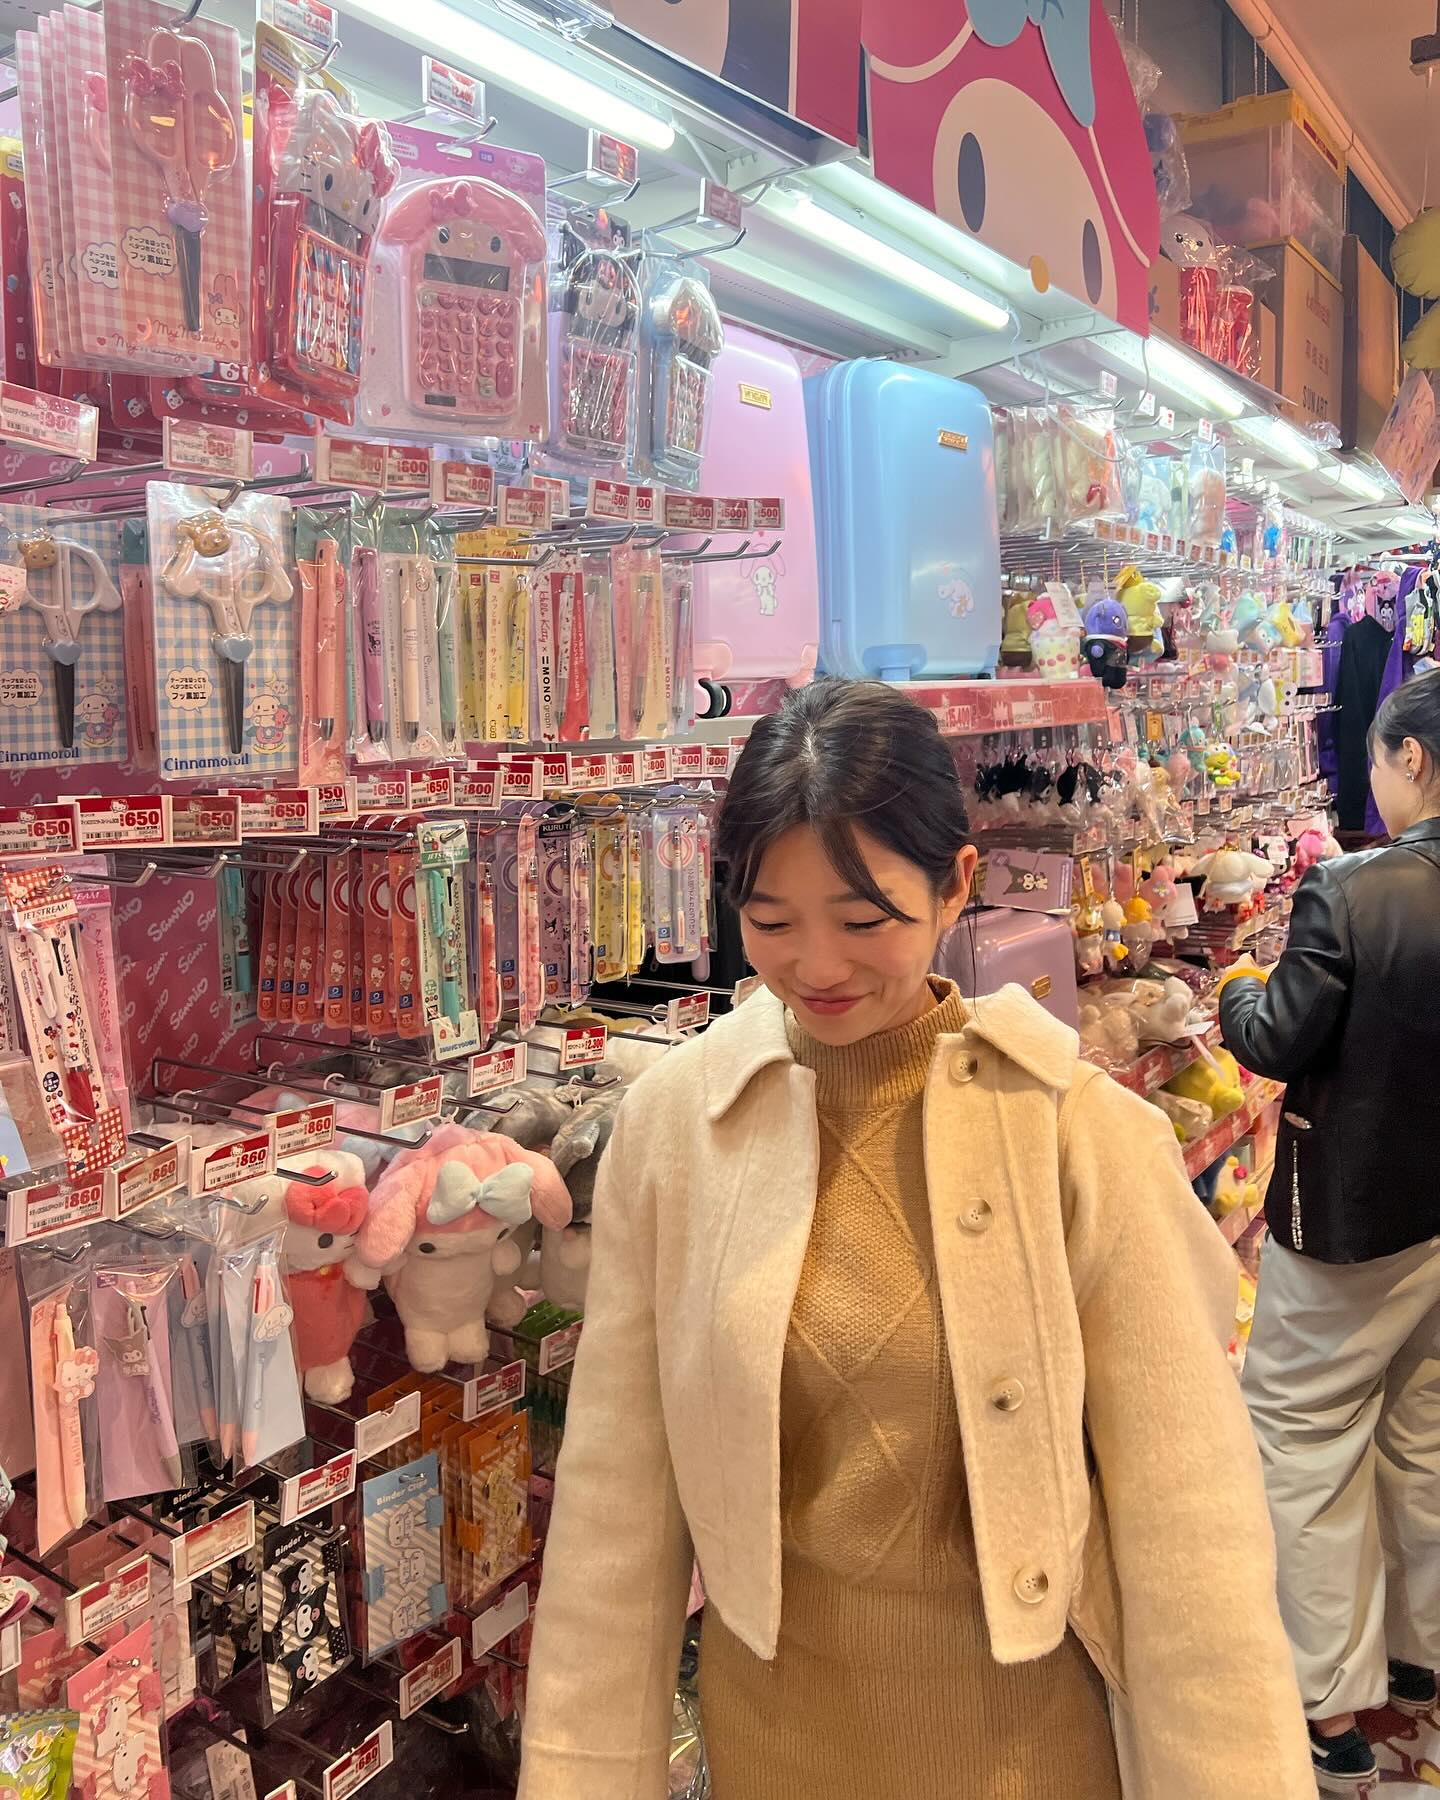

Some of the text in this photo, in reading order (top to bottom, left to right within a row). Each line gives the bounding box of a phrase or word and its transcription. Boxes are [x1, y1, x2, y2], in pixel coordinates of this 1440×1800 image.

[538, 591, 549, 618] Hello
[538, 619, 550, 643] Kitty
[542, 666, 551, 703] MONO
[650, 759, 665, 771] 800
[680, 753, 700, 765] 800
[708, 756, 726, 767] 800
[589, 765, 606, 777] 800
[617, 764, 632, 775] 800
[430, 779, 448, 794] 650
[507, 773, 531, 785] 800
[377, 783, 405, 796] 650
[467, 783, 492, 795] 800
[125, 811, 160, 826] 650
[202, 812, 233, 827] 650
[275, 804, 306, 818] 650
[33, 820, 70, 837] 650
[23, 903, 69, 921] JETSTREAM
[148, 890, 195, 942] Sanrio
[169, 977, 209, 1031] Sanrio
[587, 1037, 604, 1050] 2,300
[496, 1059, 514, 1074] 2,300
[307, 1117, 331, 1135] 860
[240, 1149, 267, 1168] 860
[152, 1159, 176, 1183] 860
[69, 1187, 101, 1208] 860
[329, 1466, 349, 1487] 550
[376, 1488, 406, 1506] Binder
[274, 1536, 302, 1557] Binder
[358, 1747, 378, 1770] 680
